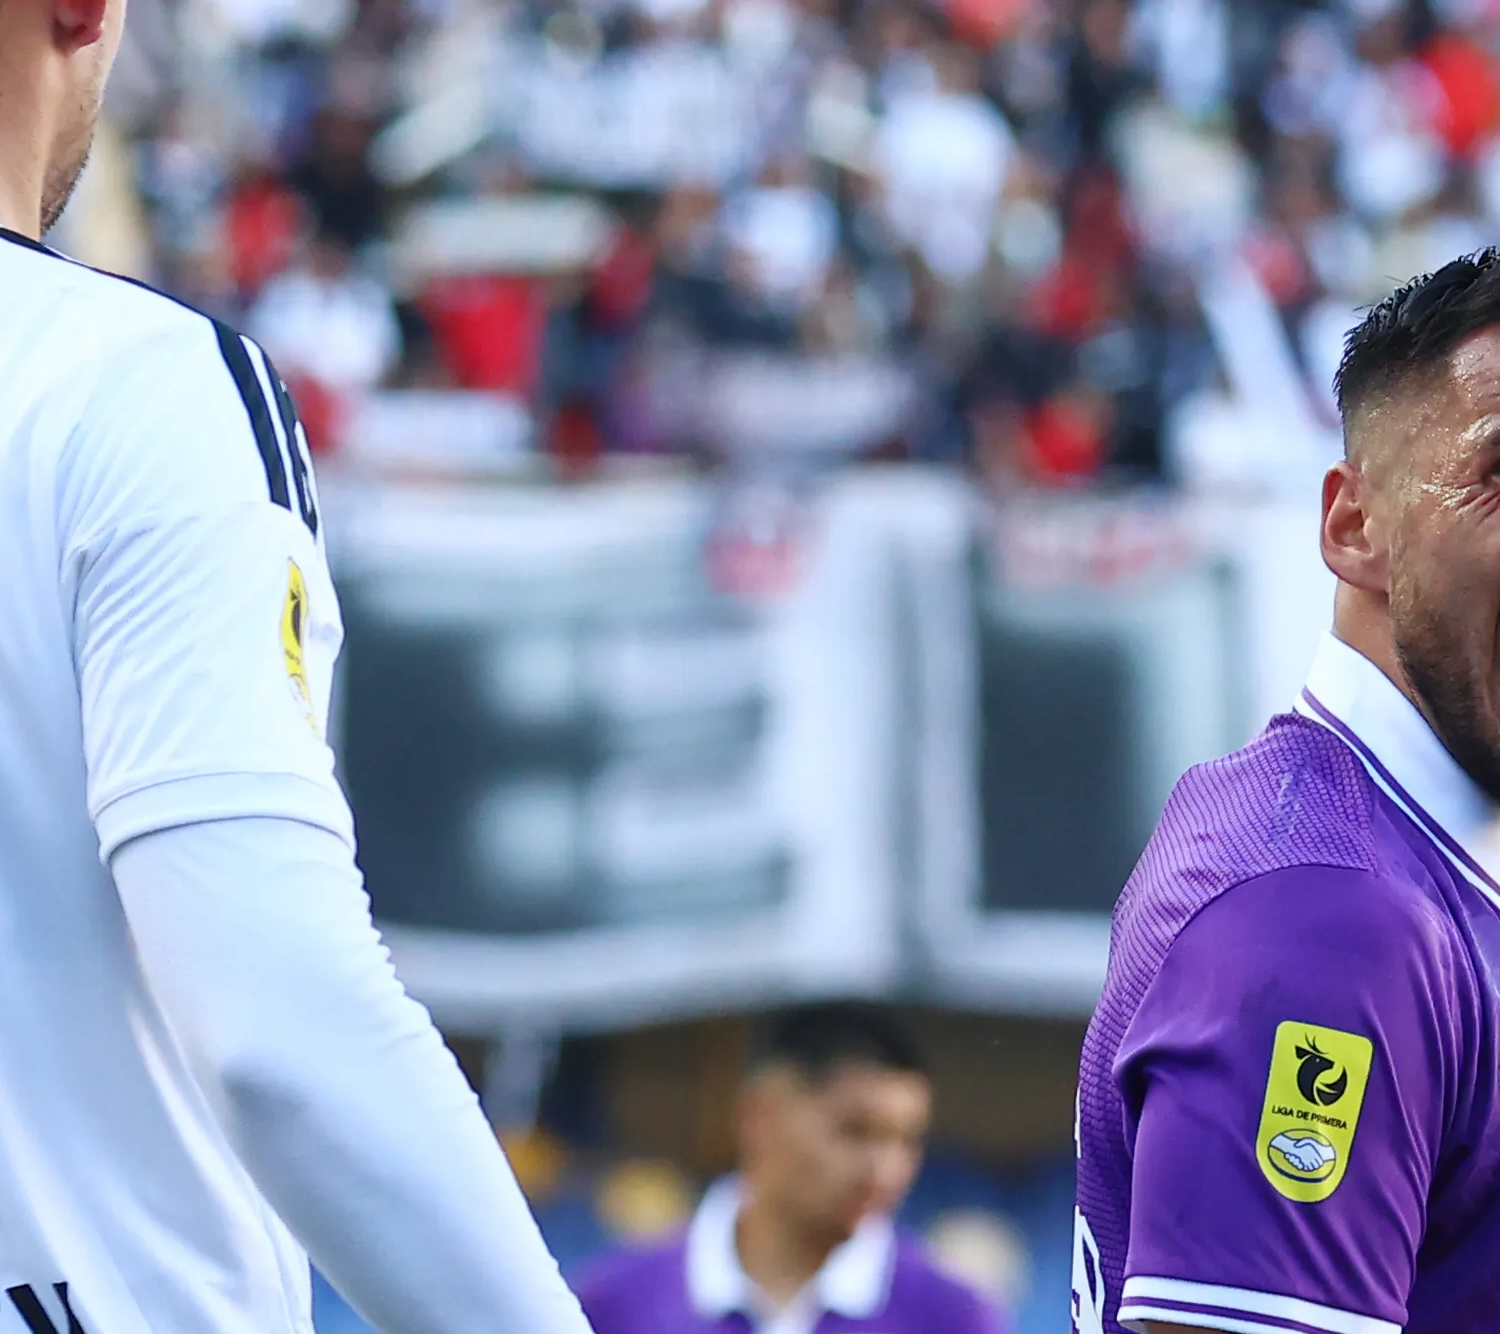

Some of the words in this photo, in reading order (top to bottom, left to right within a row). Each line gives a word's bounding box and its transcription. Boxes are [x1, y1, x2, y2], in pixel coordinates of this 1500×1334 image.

[1272, 1105, 1294, 1117] LIGA
[1296, 1110, 1310, 1120] DE
[1311, 1113, 1347, 1129] PRIMERA
